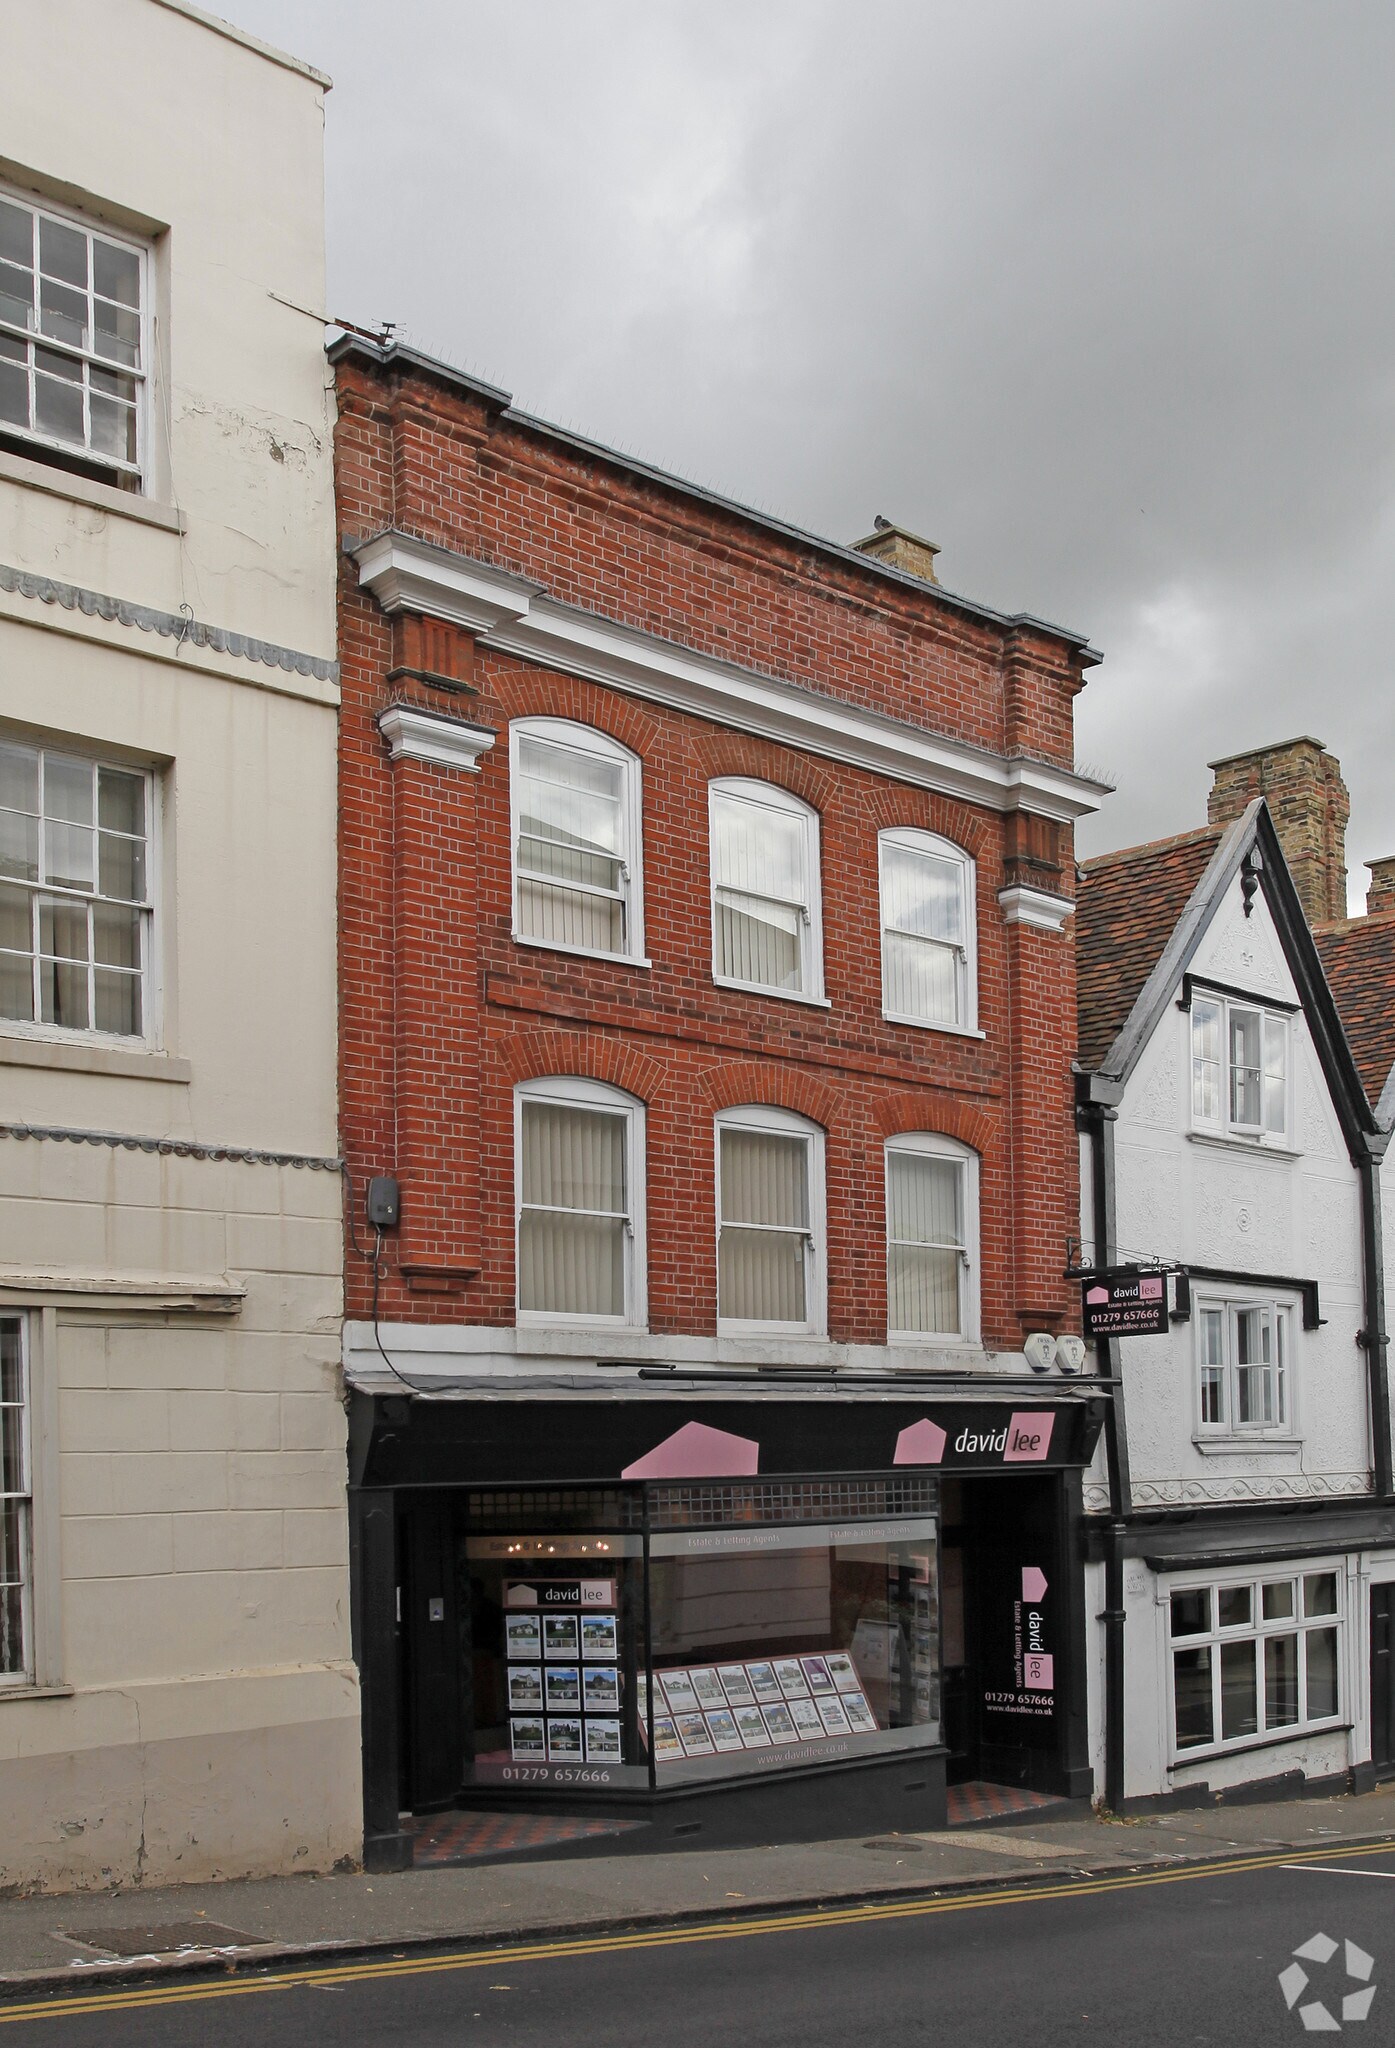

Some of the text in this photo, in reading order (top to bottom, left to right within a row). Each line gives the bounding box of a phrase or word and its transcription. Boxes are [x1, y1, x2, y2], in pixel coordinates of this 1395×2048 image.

[1113, 1285, 1156, 1298] david lee
[1091, 1309, 1159, 1323] 01279 657666
[1092, 1320, 1158, 1332] www.davidlee.co.uk
[955, 1428, 1040, 1452] david lee
[688, 1534, 780, 1547] Estate & Letting Agents
[545, 1588, 603, 1601] david lee
[1014, 1632, 1022, 1660] Letting
[1028, 1611, 1044, 1678] david lee
[1014, 1661, 1023, 1688] Agents
[985, 1692, 1054, 1706] 01279 657666
[987, 1704, 1052, 1715] www.davidlee.co.uk
[757, 1741, 848, 1765] www.davidlee.co.uk
[502, 1767, 609, 1782] 01279 657666
